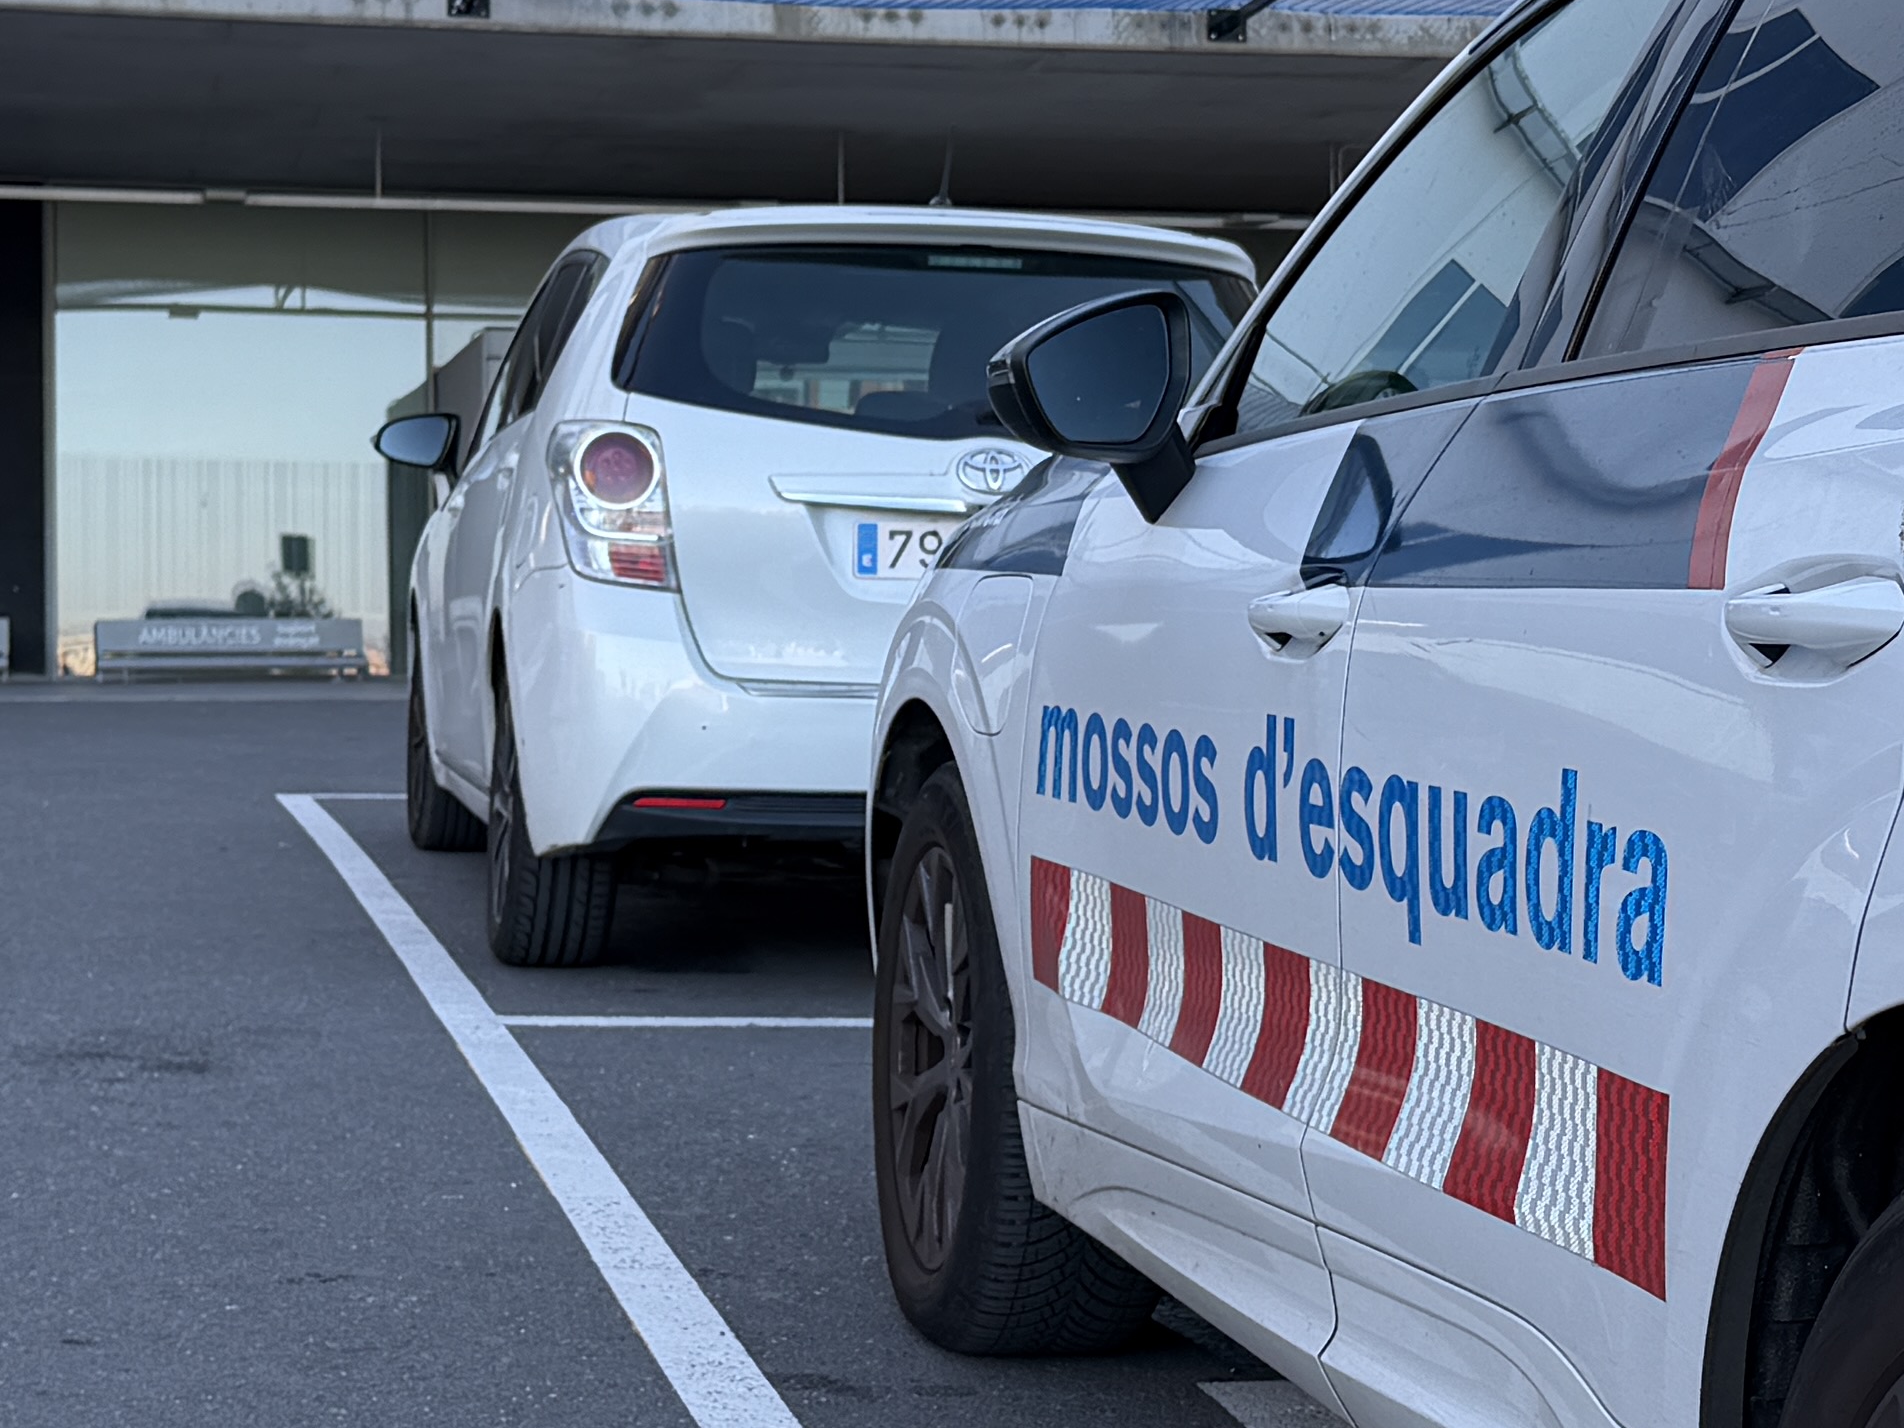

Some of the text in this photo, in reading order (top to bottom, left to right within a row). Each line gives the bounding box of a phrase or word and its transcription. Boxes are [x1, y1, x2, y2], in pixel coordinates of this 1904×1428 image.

[137, 622, 263, 646] AMBULÀNCIES
[1036, 704, 1671, 988] mossos d'esquadra
